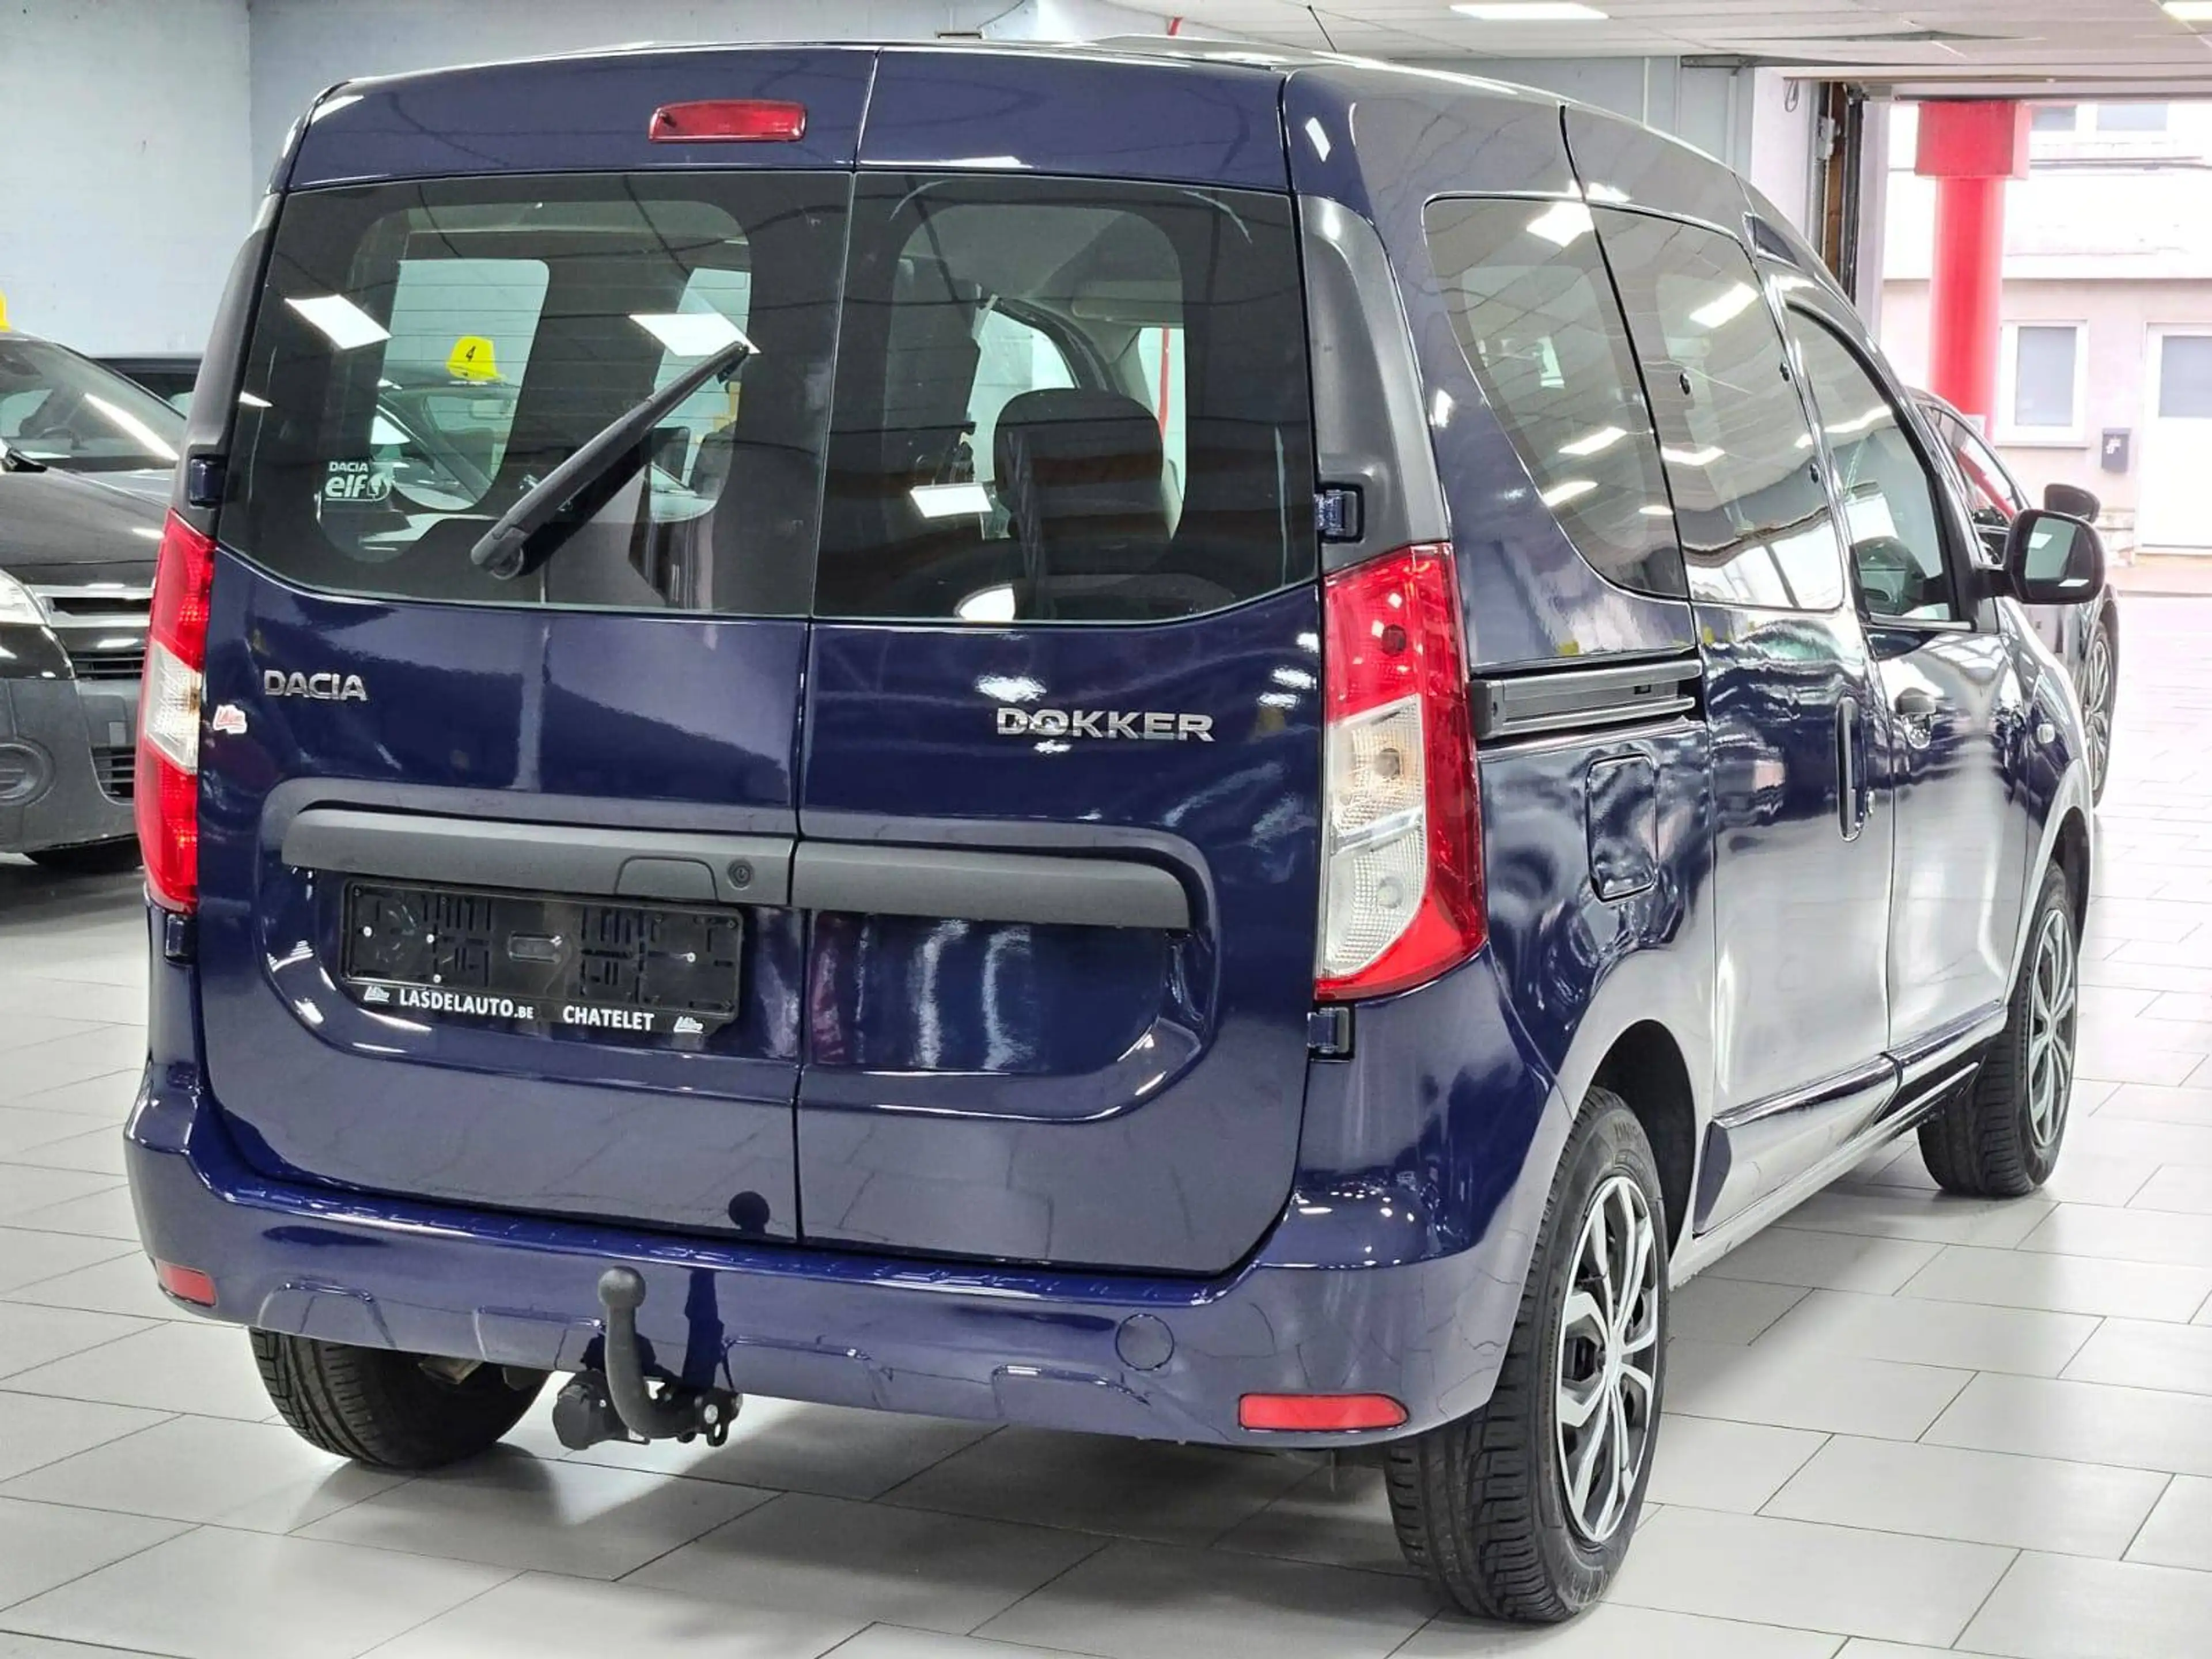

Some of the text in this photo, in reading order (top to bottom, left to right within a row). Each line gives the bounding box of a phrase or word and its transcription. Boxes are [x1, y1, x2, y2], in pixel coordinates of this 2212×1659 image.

[328, 461, 369, 472] DACIA
[325, 474, 369, 497] elf
[264, 669, 368, 702] DACIA
[997, 707, 1215, 742] DOKKER
[562, 1005, 655, 1031] CHATELET
